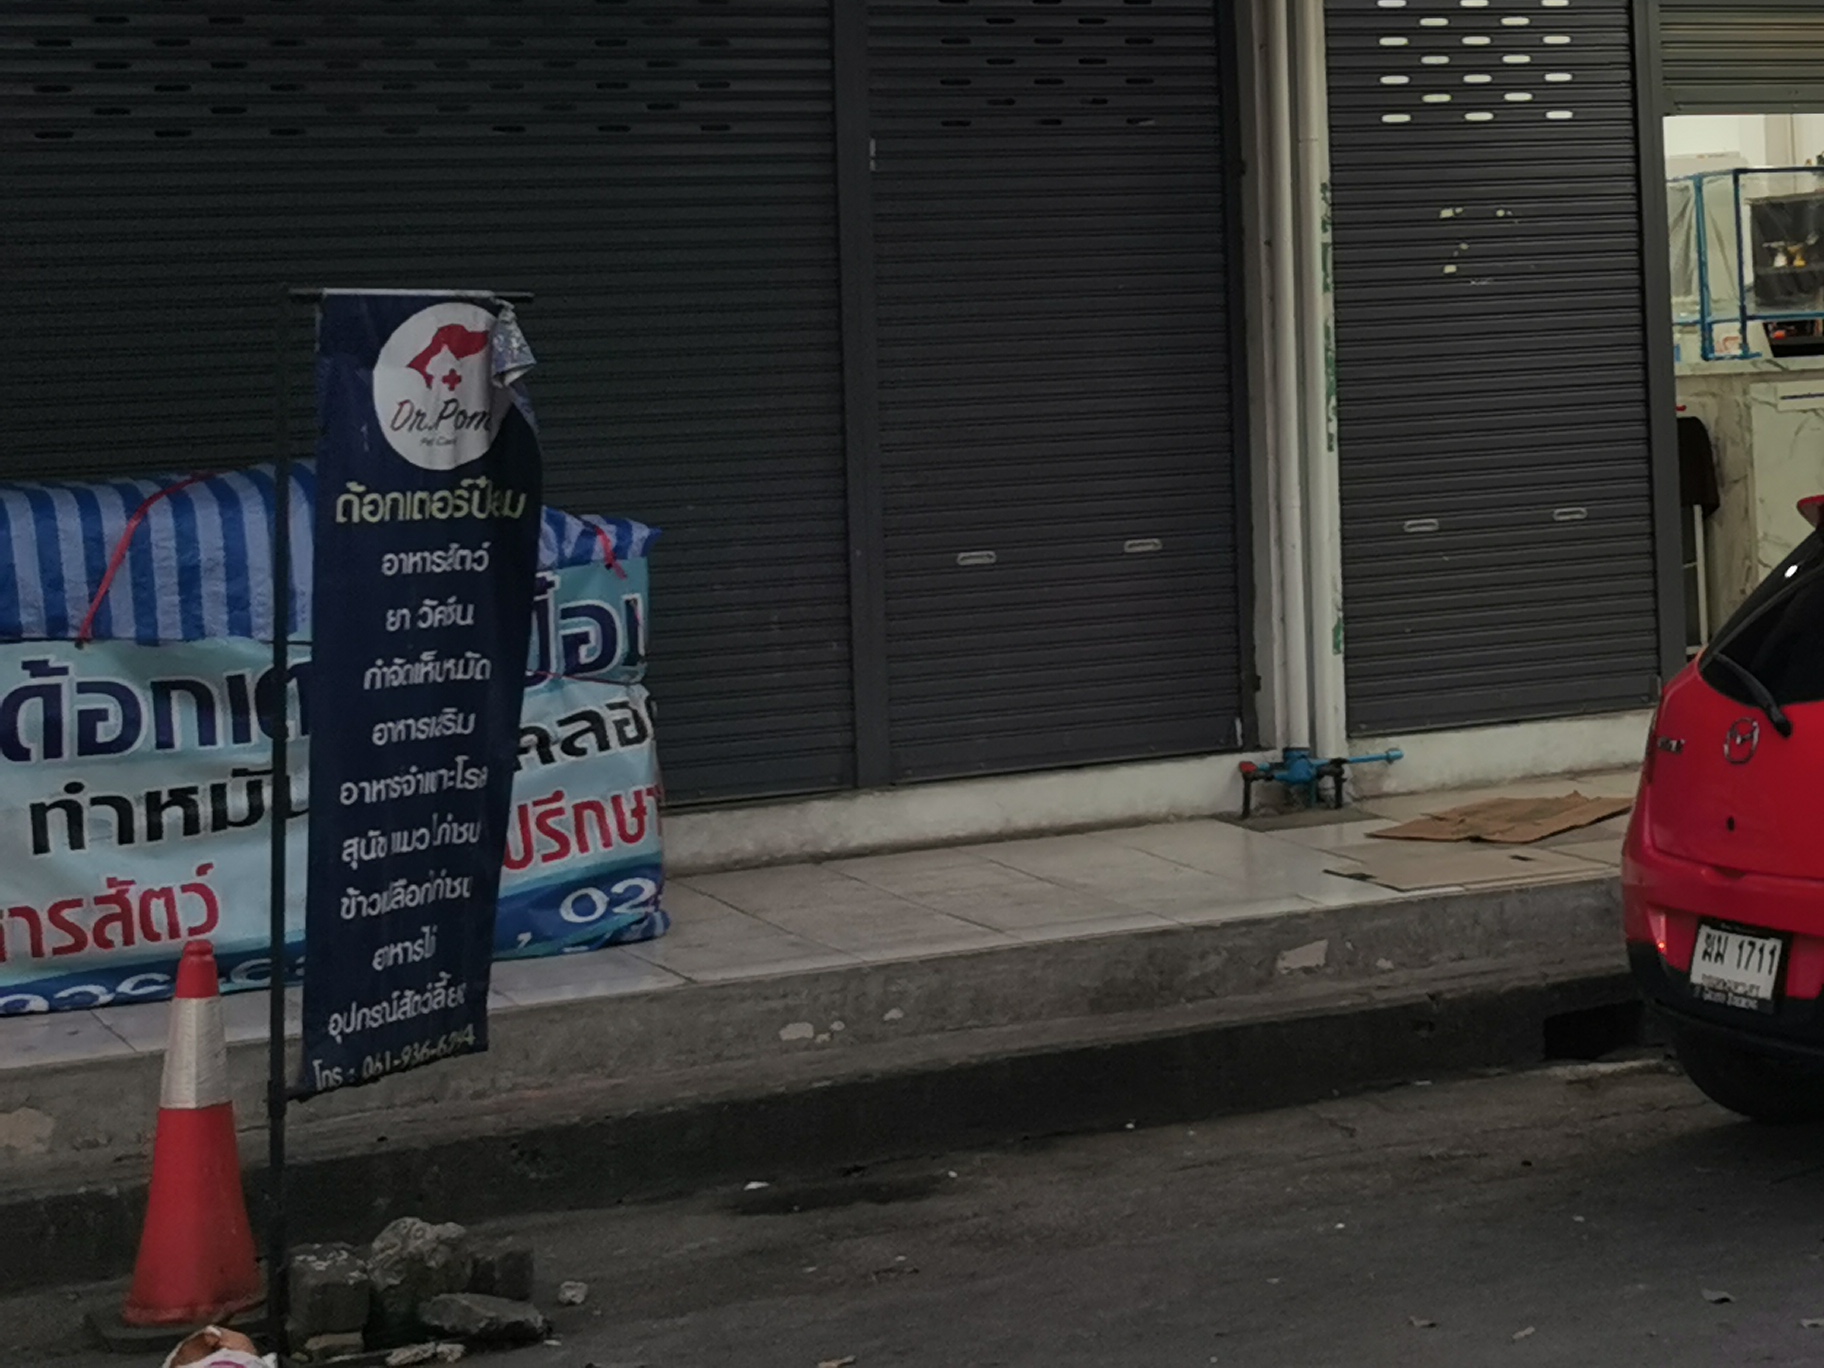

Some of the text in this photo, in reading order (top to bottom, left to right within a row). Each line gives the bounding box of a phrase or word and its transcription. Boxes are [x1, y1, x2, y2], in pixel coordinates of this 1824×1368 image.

[0, 863, 219, 963] ารสัตว์
[1736, 940, 1777, 976] 1711
